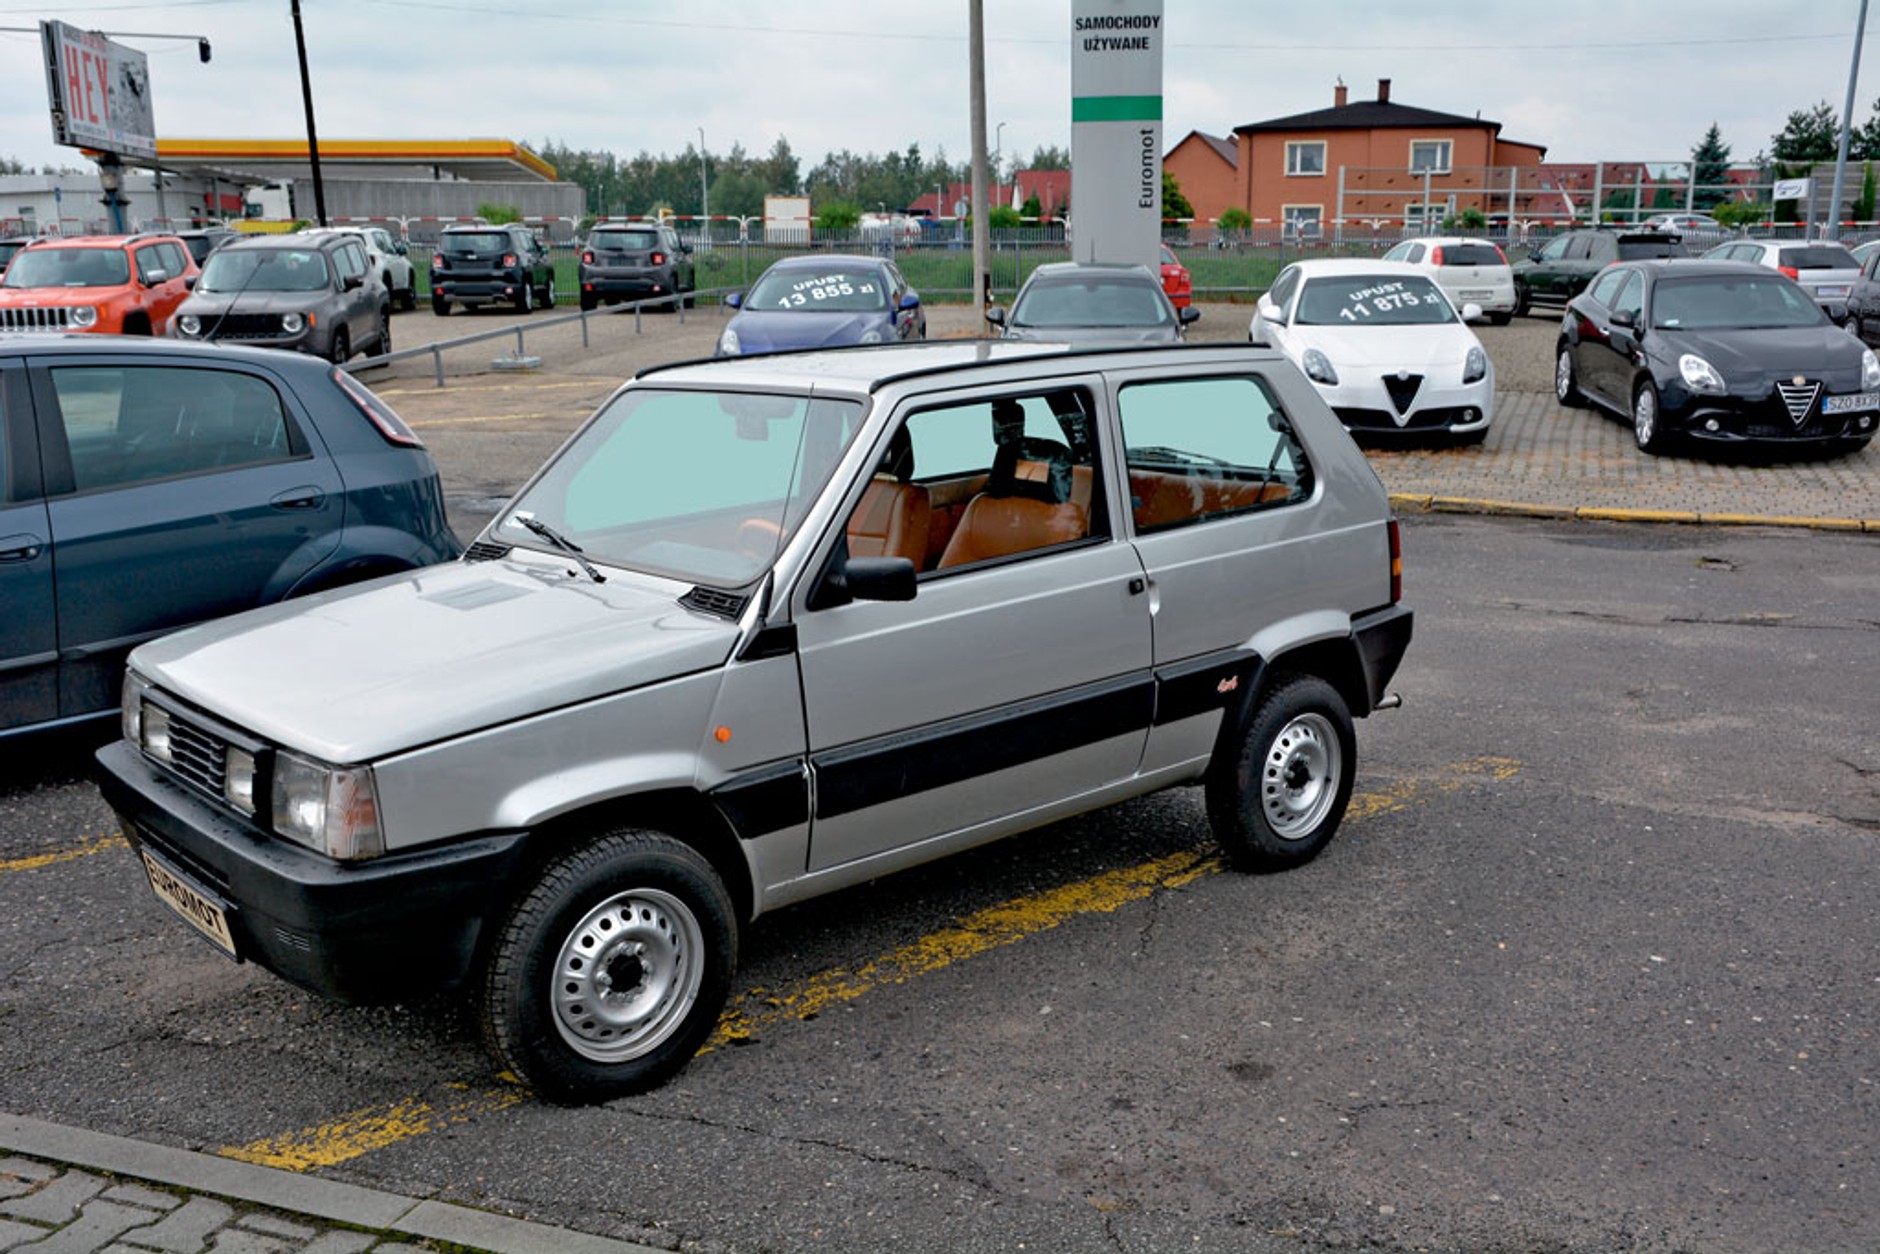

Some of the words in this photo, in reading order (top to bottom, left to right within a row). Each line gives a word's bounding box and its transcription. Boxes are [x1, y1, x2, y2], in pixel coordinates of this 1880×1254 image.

[1075, 14, 1161, 31] SAMOCHODY
[1083, 34, 1150, 52] UŻYWANE
[64, 43, 110, 125] HEY
[1139, 128, 1154, 208] Euromot
[778, 292, 806, 309] 13
[811, 282, 854, 301] 855
[793, 274, 845, 292] UPUST
[1349, 282, 1404, 302] UPUST
[1340, 303, 1371, 321] 11
[1373, 291, 1420, 312] 875
[145, 855, 224, 935] EUROMOT
